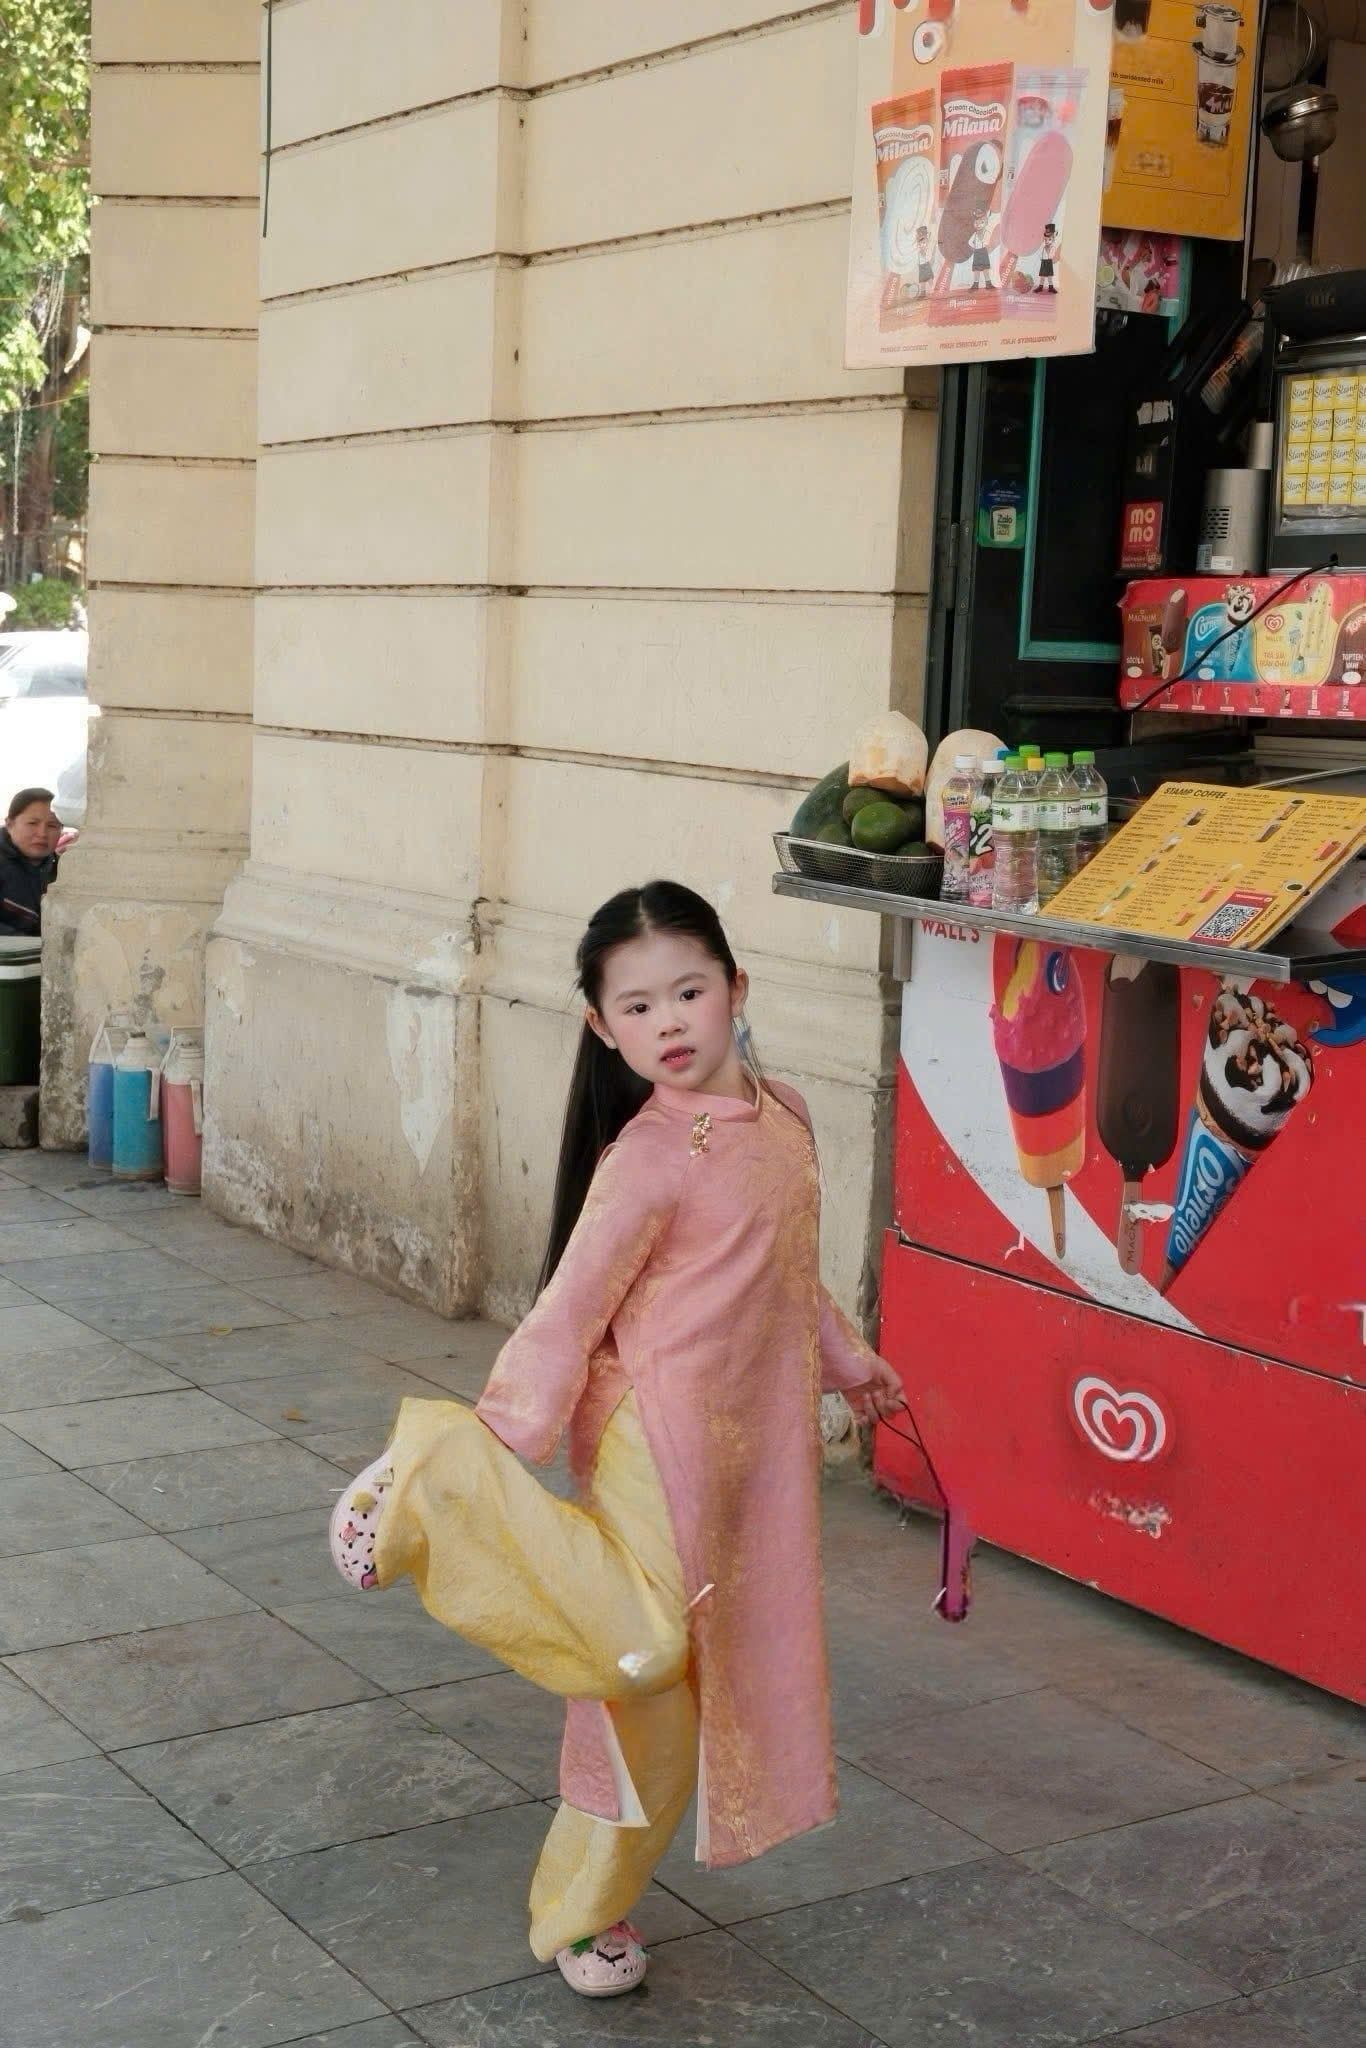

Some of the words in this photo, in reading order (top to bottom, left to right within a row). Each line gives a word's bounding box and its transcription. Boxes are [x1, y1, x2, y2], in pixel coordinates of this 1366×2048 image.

[943, 117, 1000, 137] Milana
[876, 138, 930, 162] Milana
[1163, 787, 1193, 797] STAMP
[1193, 789, 1228, 799] COFFEE
[921, 919, 980, 943] WALLS
